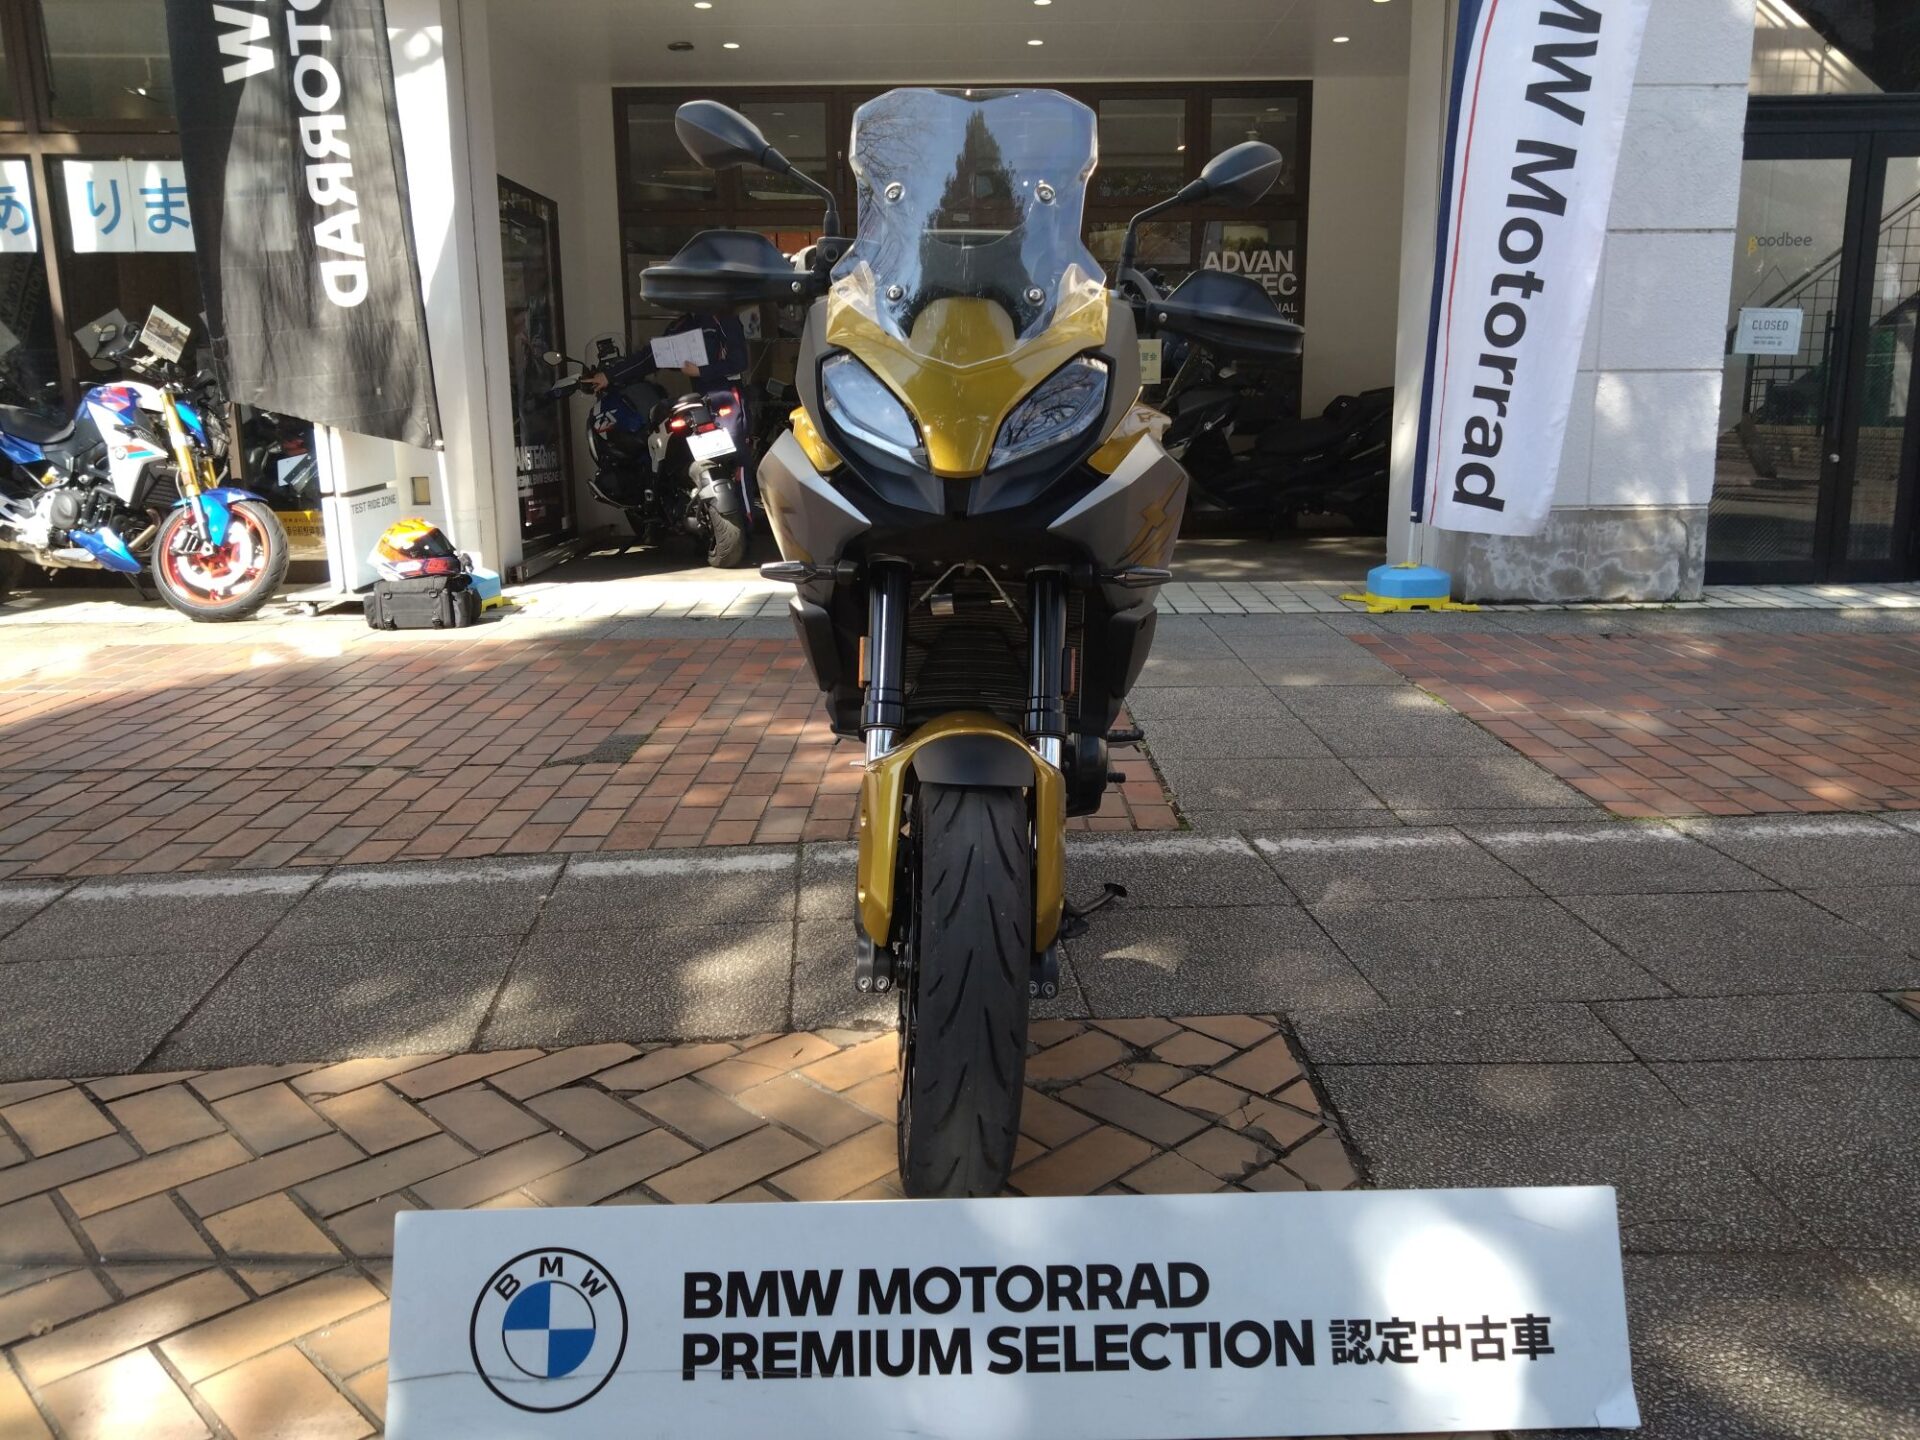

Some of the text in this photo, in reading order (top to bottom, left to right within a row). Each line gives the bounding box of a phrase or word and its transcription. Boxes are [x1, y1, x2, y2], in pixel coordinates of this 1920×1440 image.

[1203, 250, 1293, 273] ADVAN
[1452, 138, 1578, 513] Motorrad
[1752, 320, 1789, 331] CLOSED
[351, 494, 397, 515] TEST RIDE ZONE
[494, 1256, 608, 1301] BMW
[683, 1262, 1210, 1319] BMW MOTORRAD
[682, 1313, 1555, 1381] PREMIUM SELECTION 認定中古車
